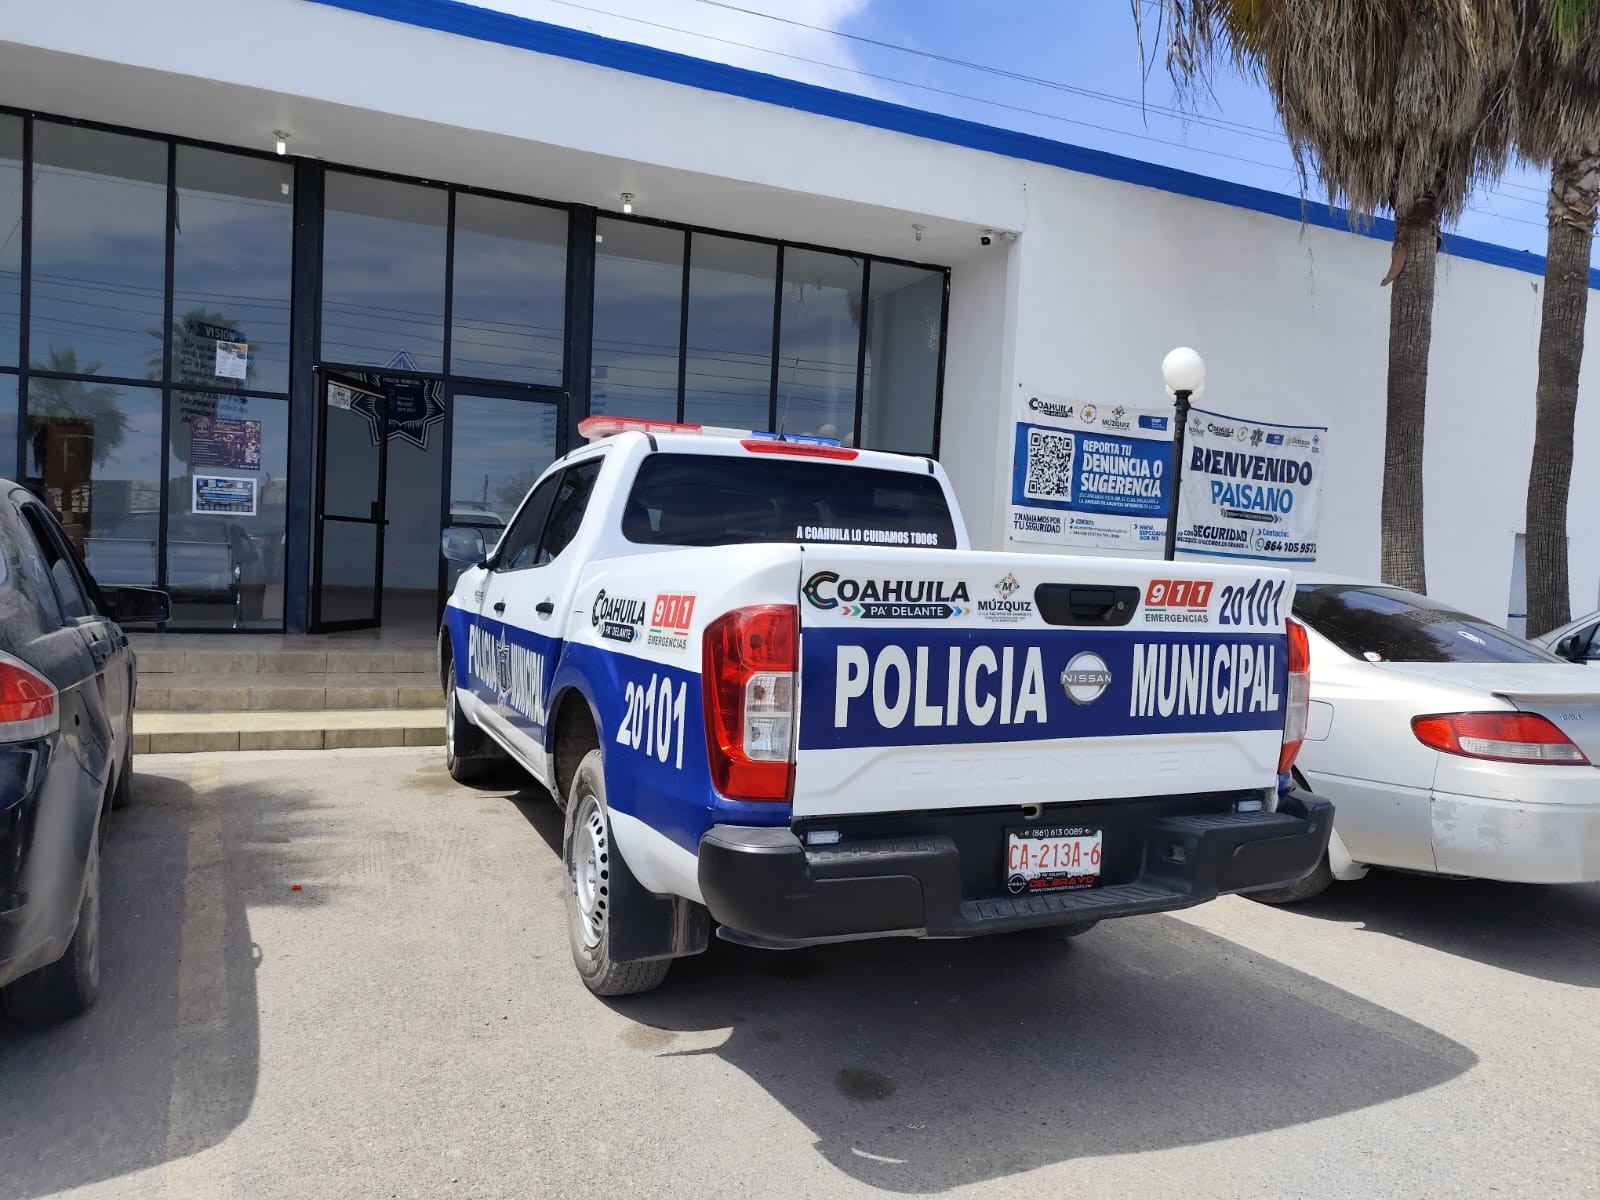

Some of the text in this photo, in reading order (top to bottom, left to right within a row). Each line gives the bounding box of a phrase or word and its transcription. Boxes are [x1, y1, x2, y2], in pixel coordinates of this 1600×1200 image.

[1029, 397, 1073, 413] COAHUILA
[1083, 440, 1132, 456] REPORTA TU
[1082, 453, 1163, 478] DENUNCIA O
[1190, 446, 1313, 486] BIENVENIDO
[1081, 473, 1161, 497] SUGERENCIA
[1211, 480, 1293, 513] PAISANO
[1014, 513, 1061, 525] TRABAJAMOS POR
[1014, 521, 1061, 533] TU SEGURIDAD
[796, 526, 938, 545] A COAHUILA LO CUIDAMOS TODOS
[1193, 525, 1247, 542] SEGURIDAD
[1264, 540, 1282, 551] 864
[1284, 542, 1299, 552] 105
[802, 571, 970, 609] COAHUILA
[1148, 582, 1208, 604] 911
[592, 589, 646, 626] COAHUILA
[654, 599, 690, 625] 911
[898, 606, 944, 617] DELANTE
[978, 598, 1032, 613] MÚZQUIZ
[1219, 578, 1286, 626] 20101
[1145, 614, 1209, 624] EMERGENCIAS
[611, 626, 632, 640] DELANTE
[647, 634, 688, 650] EMERGENCIAS
[468, 623, 545, 726] POLICIA MUNICIPAL
[1062, 673, 1112, 684] NISSAN
[1129, 643, 1280, 718] MUNICIPAL
[834, 644, 1048, 729] POLICIA
[616, 673, 687, 770] 20101
[896, 749, 1218, 789] FRONTIER
[1032, 828, 1083, 837] (861) 613 0089
[1009, 842, 1100, 870] CA-213A-6
[1030, 876, 1094, 888] DEL BRAVO
